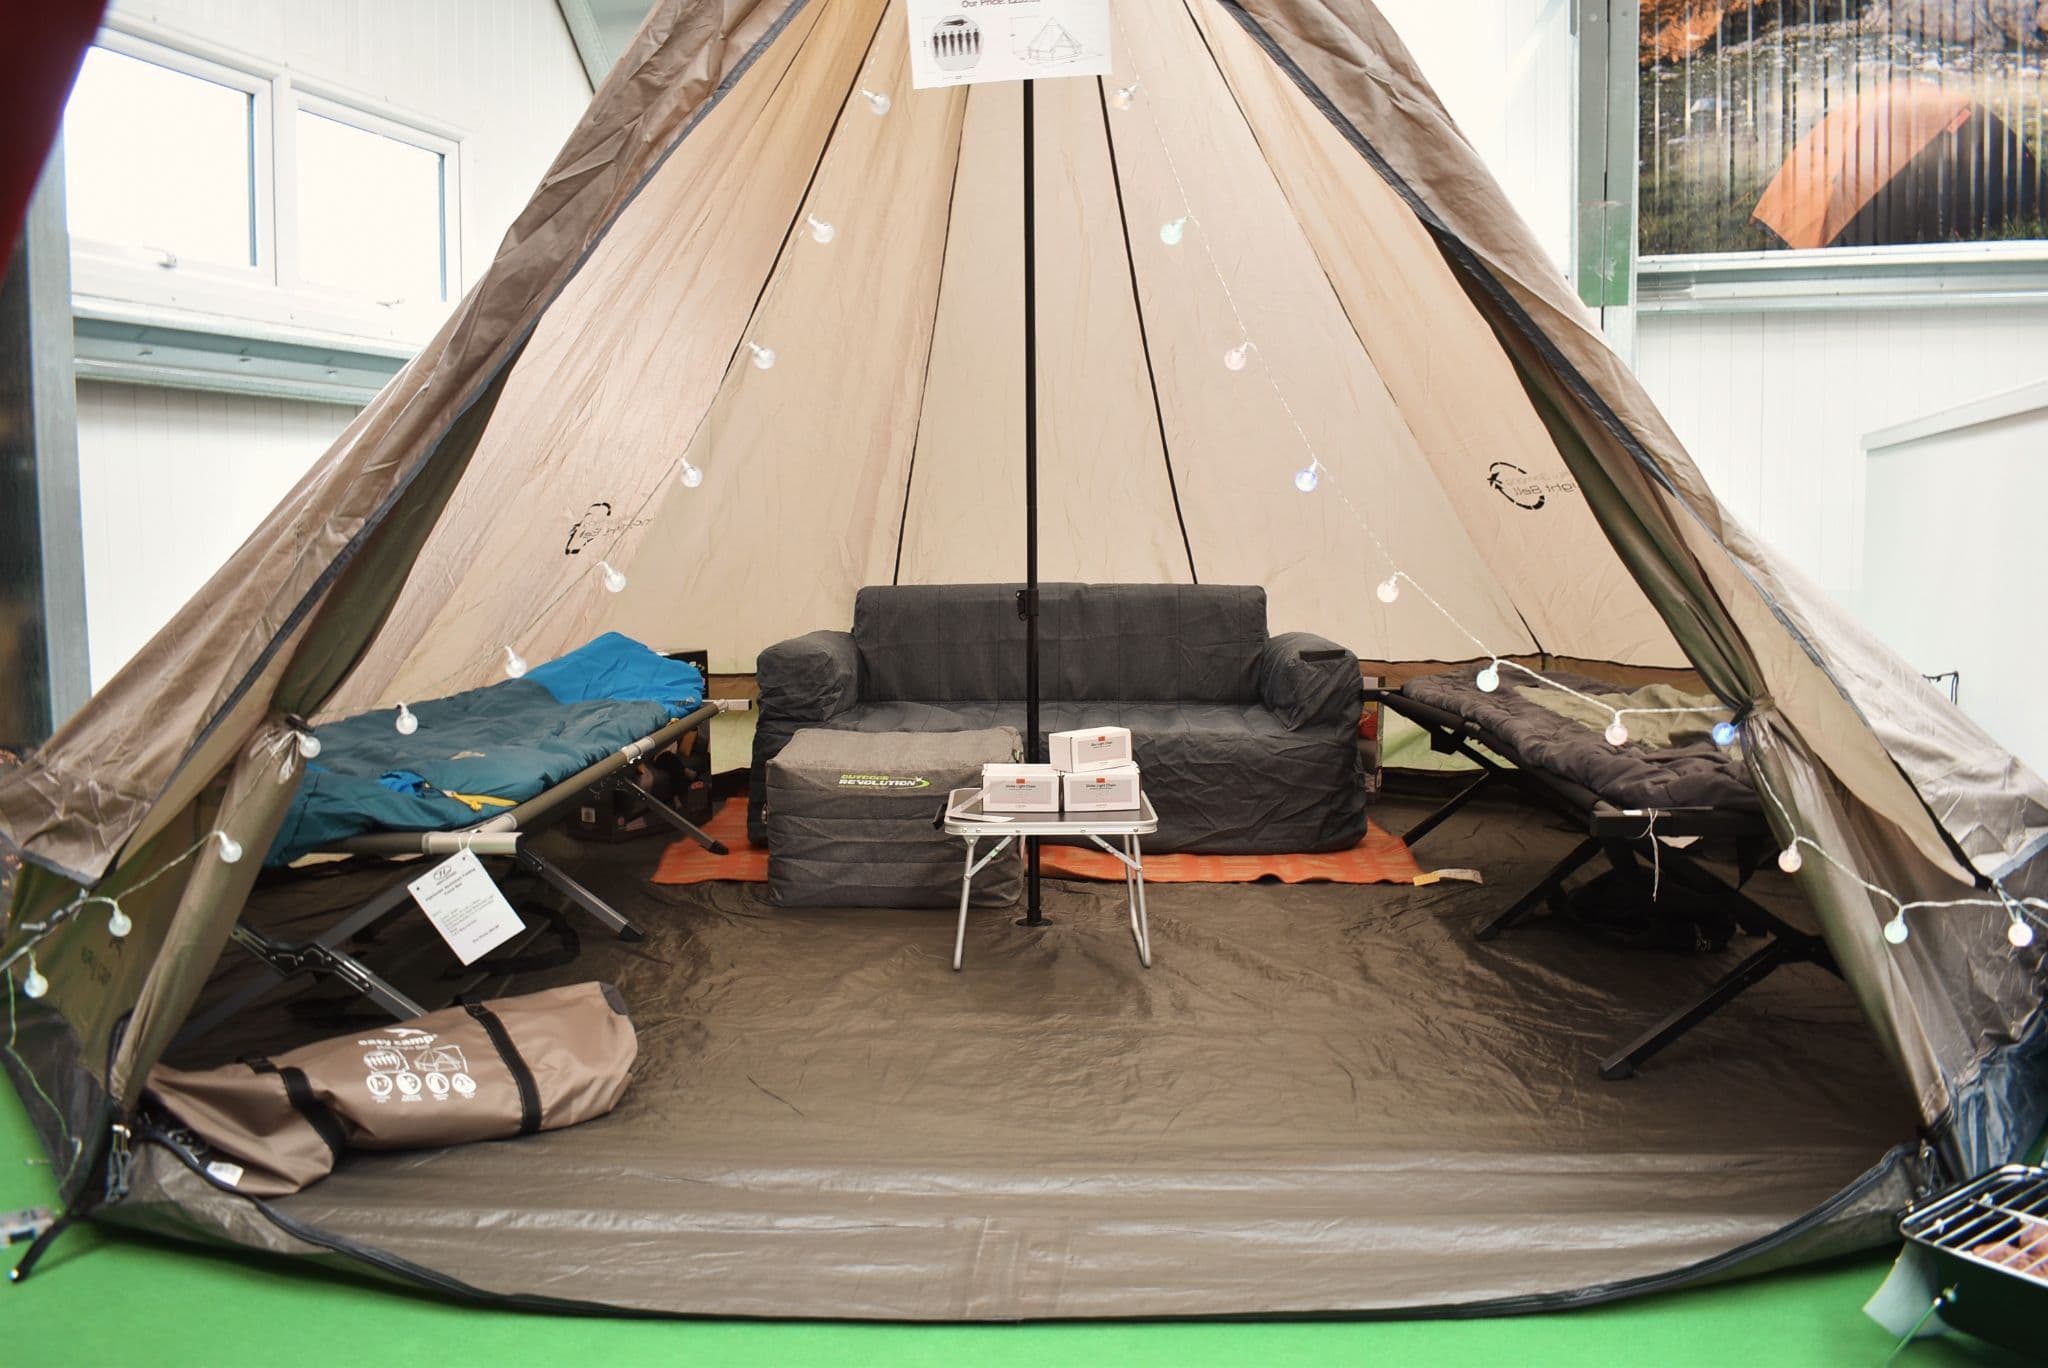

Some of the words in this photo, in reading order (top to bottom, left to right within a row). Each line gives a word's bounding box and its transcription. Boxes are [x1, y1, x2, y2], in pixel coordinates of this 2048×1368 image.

[961, 0, 978, 8] Our
[358, 1039, 392, 1047] easy
[393, 1035, 434, 1046] camp
